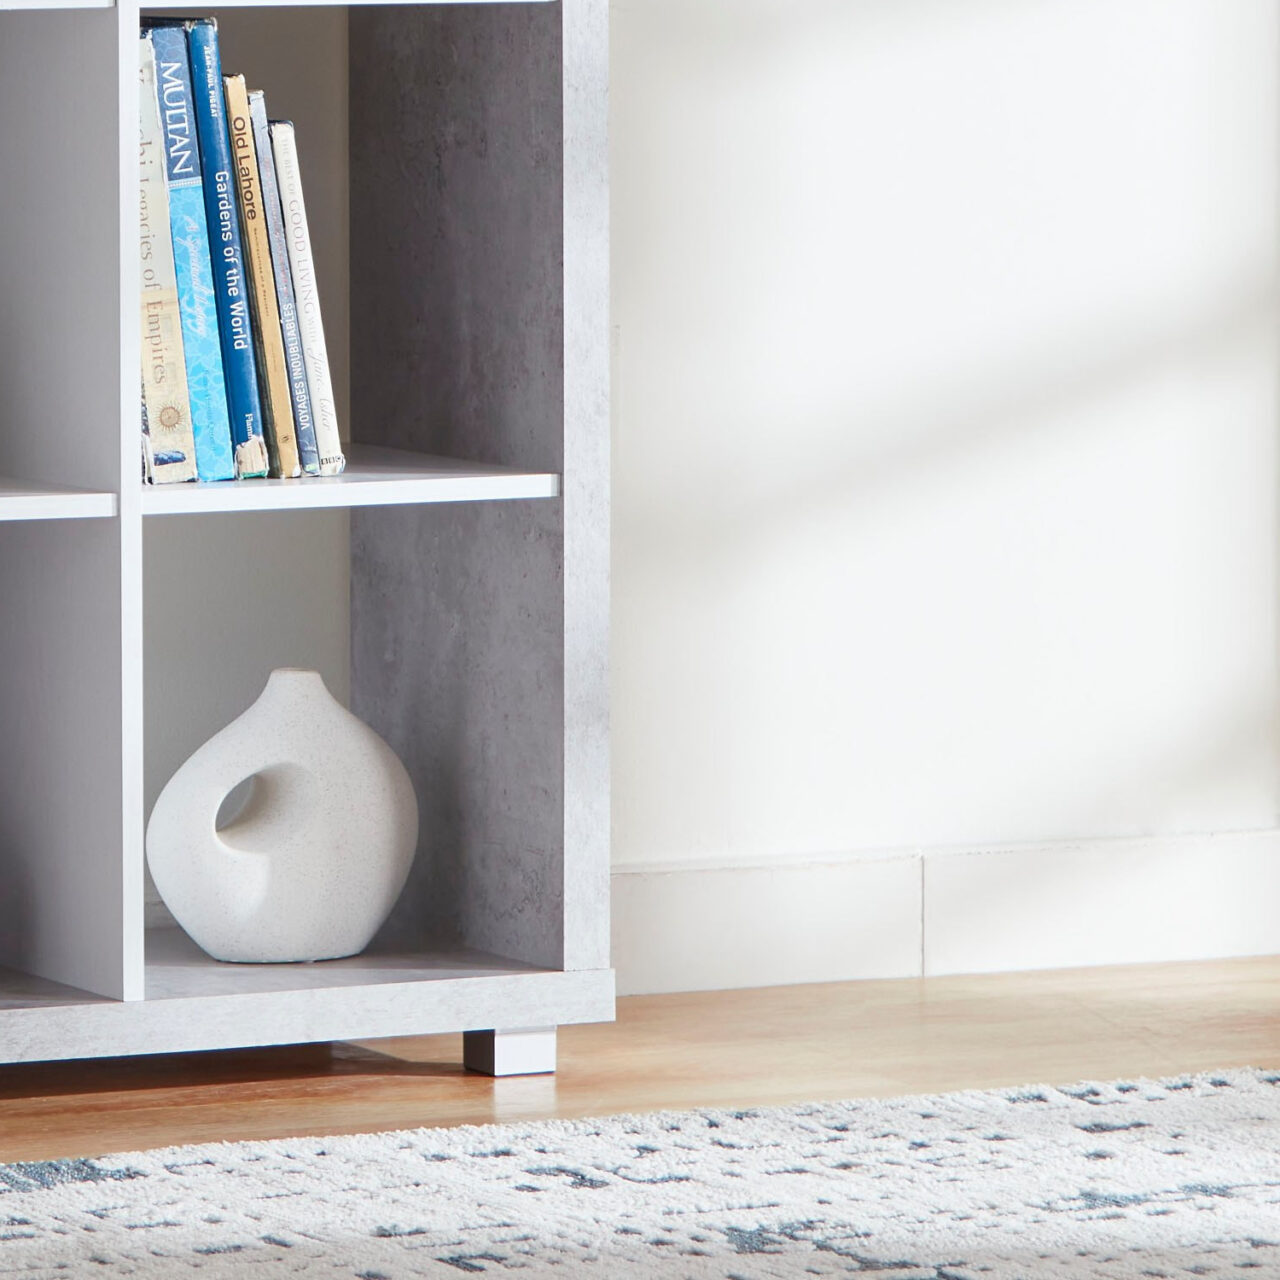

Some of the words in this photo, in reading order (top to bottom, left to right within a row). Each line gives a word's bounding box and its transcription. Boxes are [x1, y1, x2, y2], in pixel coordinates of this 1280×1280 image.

[160, 62, 194, 174] MULTAN
[233, 116, 248, 148] Old
[215, 171, 233, 241] Gardens
[239, 154, 256, 220] Lahore
[289, 200, 306, 253] GOOD
[143, 269, 161, 291] of
[223, 247, 239, 268] of
[226, 269, 240, 297] the
[296, 258, 317, 314] LIVING
[146, 299, 169, 384] Empires
[229, 301, 248, 350] World
[282, 303, 303, 380] INOUBLIABLES
[294, 381, 310, 430] VOYAGES
